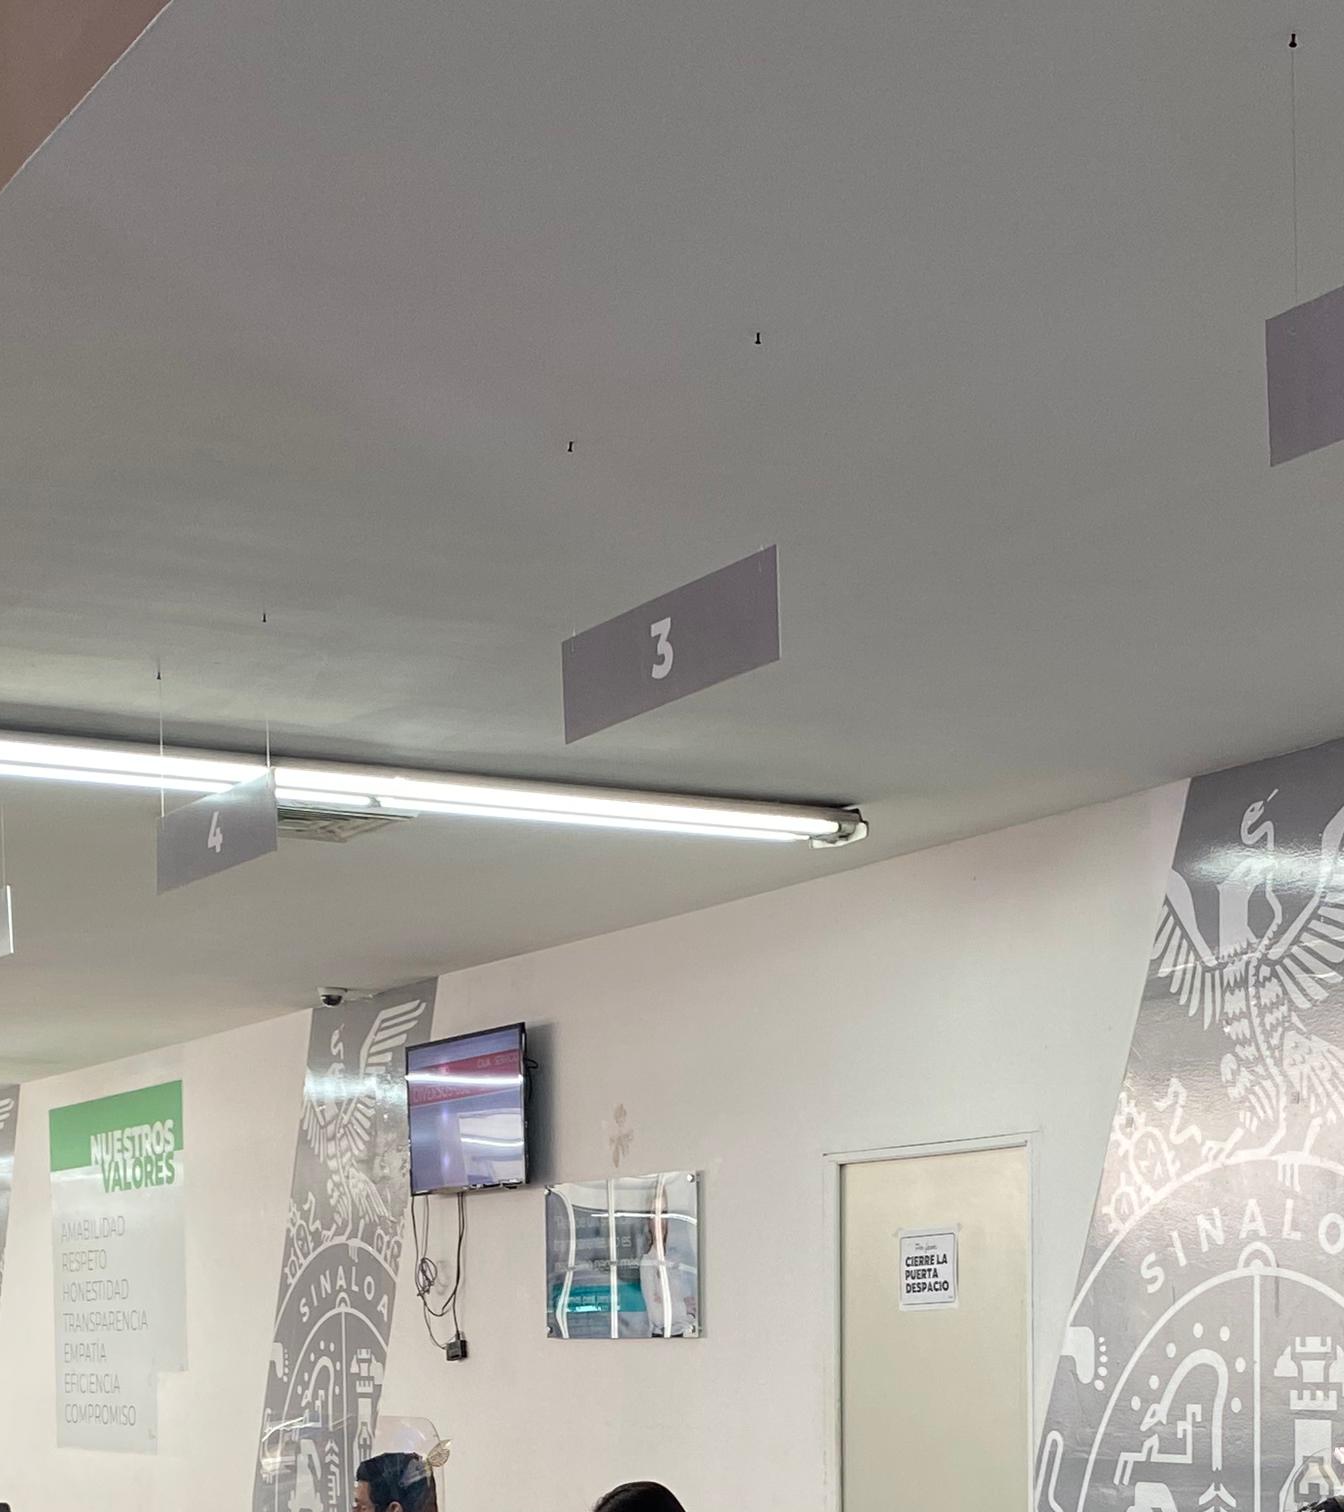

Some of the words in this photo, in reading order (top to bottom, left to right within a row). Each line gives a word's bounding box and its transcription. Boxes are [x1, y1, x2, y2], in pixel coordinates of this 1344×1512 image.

[650, 616, 674, 680] 3
[207, 810, 224, 853] 4
[90, 1119, 175, 1166] NUESTROS
[101, 1151, 175, 1193] VALORES
[60, 1214, 126, 1243] AMABILIDAD
[61, 1248, 108, 1273] RESPETO
[905, 1254, 935, 1267] CIERRE
[936, 1253, 948, 1265] LA
[905, 1267, 938, 1281] PUERTA
[62, 1278, 129, 1302] HONESTIDAD
[299, 1265, 388, 1323] SINALOA
[905, 1280, 950, 1294] DESPACIO
[62, 1308, 149, 1333] TRANSPARENCIA
[64, 1372, 121, 1395] EFICIENCIA
[64, 1403, 137, 1427] COMPROMISO
